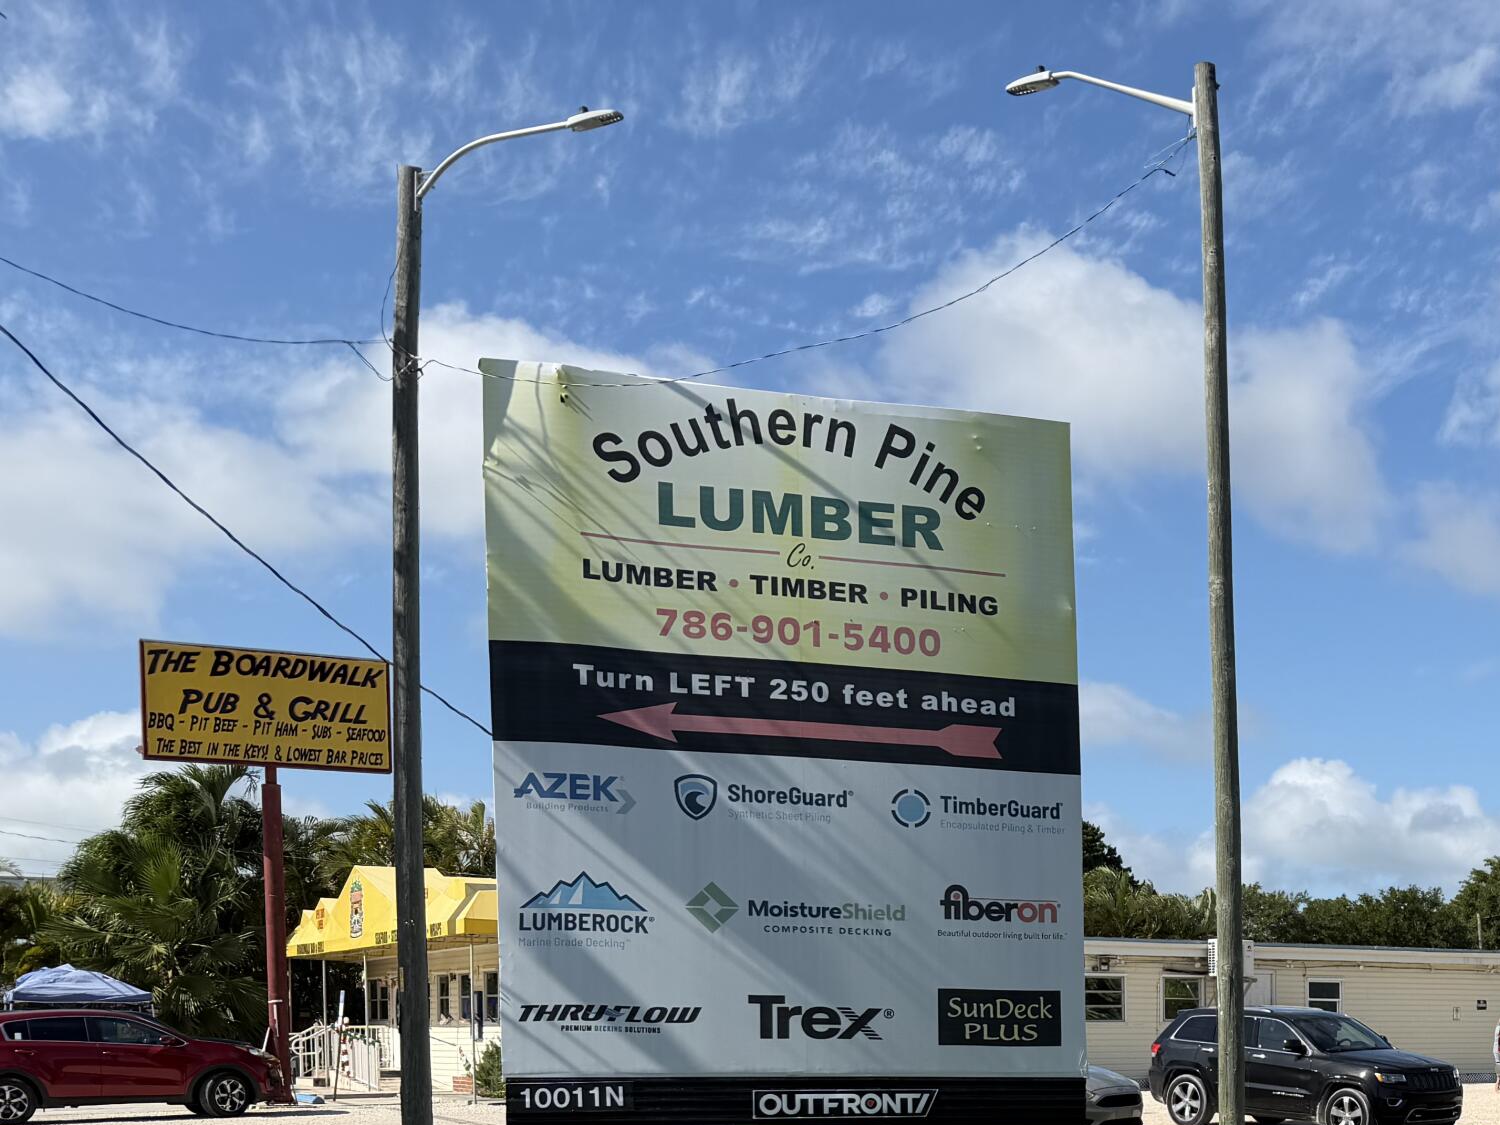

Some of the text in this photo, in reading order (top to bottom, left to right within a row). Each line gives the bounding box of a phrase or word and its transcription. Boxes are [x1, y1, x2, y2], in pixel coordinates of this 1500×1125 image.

[593, 398, 986, 521] Southern Pine
[658, 482, 944, 551] LUMBER
[786, 543, 815, 570] Co.
[582, 558, 998, 616] LUMBER TIMBER PILING
[656, 608, 941, 657] 786-901-5400
[147, 649, 385, 688] THE BOARDWALK
[573, 663, 1016, 717] Turn LEFT 250 feet ahead
[178, 689, 368, 725] PUB & GRILL
[148, 712, 175, 731] BBQ
[190, 715, 209, 731] PIT
[213, 716, 239, 733] BEEF
[253, 720, 272, 735] PIT
[275, 721, 298, 737] HAM
[312, 724, 332, 739] SUBS
[346, 727, 386, 742] SEAFOOD
[157, 738, 175, 754] THE
[179, 739, 202, 755] BEST
[207, 742, 219, 755] IN
[223, 743, 240, 757] THE
[274, 745, 282, 761] &
[287, 746, 322, 762] LOWEST
[326, 748, 347, 764] BAR
[350, 750, 383, 766] PRICES
[514, 772, 619, 802] AZEK
[940, 820, 1000, 833] Encapsulated
[748, 900, 906, 921] MoistureShield
[764, 925, 892, 937] COMPOSITE DECKING
[937, 929, 971, 938] Beautiful
[972, 930, 1001, 939] outdoor
[1002, 931, 1023, 941] living
[947, 996, 1053, 1019] SunDeck
[561, 1024, 592, 1032] PREMIUM
[624, 1026, 661, 1034] SOLUTIONS
[964, 1022, 1038, 1041] PLUS
[520, 1085, 624, 1109] 10011N
